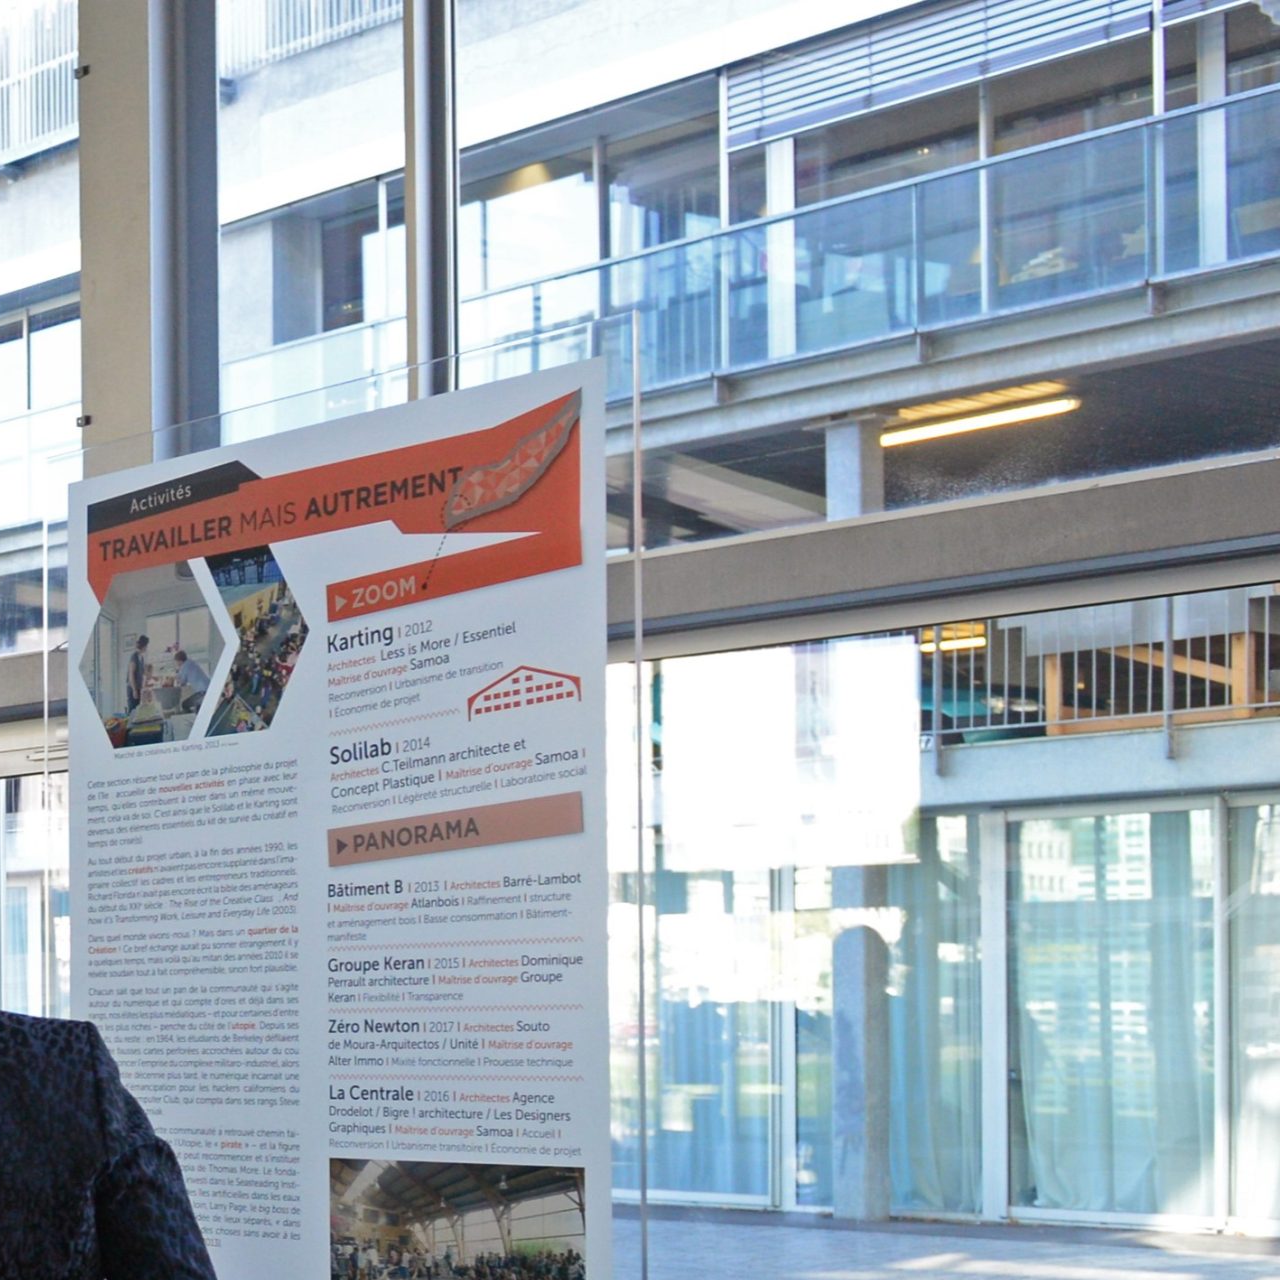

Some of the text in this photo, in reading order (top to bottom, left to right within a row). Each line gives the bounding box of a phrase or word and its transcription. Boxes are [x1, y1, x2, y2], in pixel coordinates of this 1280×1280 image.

[129, 483, 193, 514] Activités
[100, 467, 463, 562] TRAVAILLER MAIS AUTREMENT
[352, 576, 416, 609] ZOOM
[328, 621, 433, 653] Karting 2012
[328, 622, 516, 672] Architectes Less is More Essentiel
[328, 654, 450, 687] Maîtrise d'ouvrage Samoa
[328, 661, 503, 702] Reconversion Urbanisme de transition
[381, 698, 391, 708] de
[394, 693, 420, 707] projet
[330, 738, 430, 765] Solilab 2014
[330, 740, 526, 781] Architectes C.Teilmann architecte et
[331, 750, 578, 799] Concept Plastique Maîtrise d'ouvrage Samoa
[332, 798, 390, 814] Reconversion
[440, 782, 493, 797] structurelle
[500, 772, 556, 788] Laboratoire
[559, 766, 587, 779] social
[353, 818, 479, 853] PANORAMA
[328, 874, 581, 897] Bâtiment B 2013 Architectes Barré-Lambot
[334, 892, 571, 913] Maîtrise d'ouvrage Atlanbois Raffinement structure
[338, 918, 397, 930] aménagement
[399, 916, 416, 925] bois
[424, 914, 448, 924] Basse
[450, 910, 517, 923] consommation
[526, 909, 572, 919] Bâtiment-
[328, 932, 367, 941] manifeste
[328, 955, 583, 975] Groupe Keran 2015 Architectes Dominique
[328, 972, 562, 988] Perrault architecture Maîtrise d'ouvrage Groupe
[328, 991, 464, 1003] Keran Flexibilité Transparence
[328, 1020, 550, 1033] Zéro Newton 2017 Architectes Souto
[328, 1038, 573, 1051] de Moura-Arquitectos Unité Maîtrise d'ouvrage
[328, 1056, 573, 1069] Alter Immo Mixité fonctionnelle Prouesse technique
[330, 1085, 554, 1105] La Centrale 2016 Architectes Agence
[329, 1106, 570, 1123] Drodelot Bigre architecture Les Designers
[329, 1122, 555, 1139] Graphiques Maîtrise d'ouvrage Samoa Accueil
[329, 1140, 384, 1150] Reconversion
[392, 1141, 436, 1151] Urbanisme
[439, 1142, 483, 1152] transitoire
[539, 1145, 550, 1154] de
[553, 1146, 581, 1157] projet
